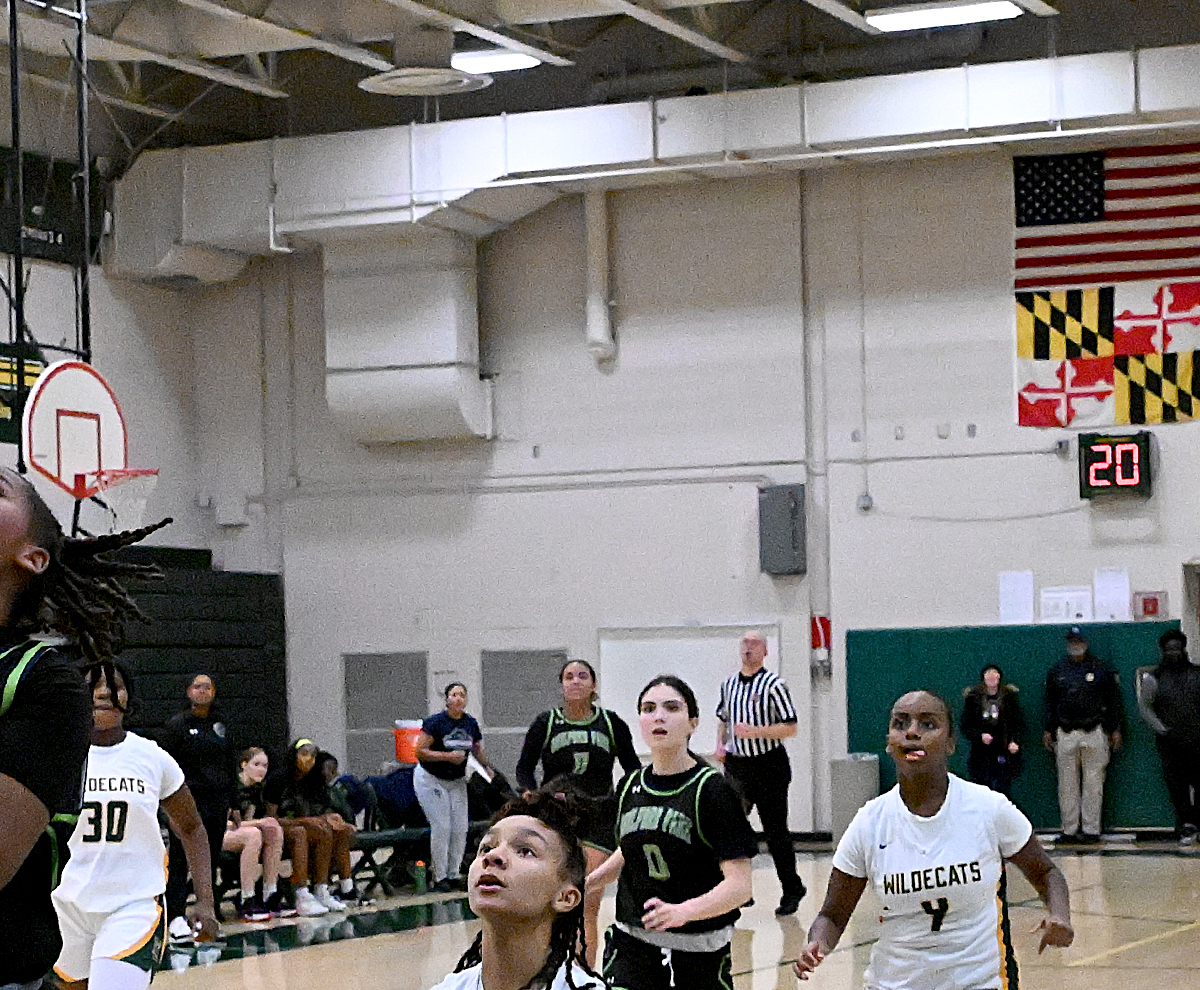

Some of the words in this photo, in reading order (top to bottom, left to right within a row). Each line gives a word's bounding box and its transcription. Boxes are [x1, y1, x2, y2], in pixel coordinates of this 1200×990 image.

[1089, 442, 1140, 486] 20
[88, 777, 145, 795] DECATS
[82, 800, 128, 843] 30
[643, 843, 671, 881] 0
[884, 861, 981, 895] WILDECATS
[920, 897, 949, 932] 4
